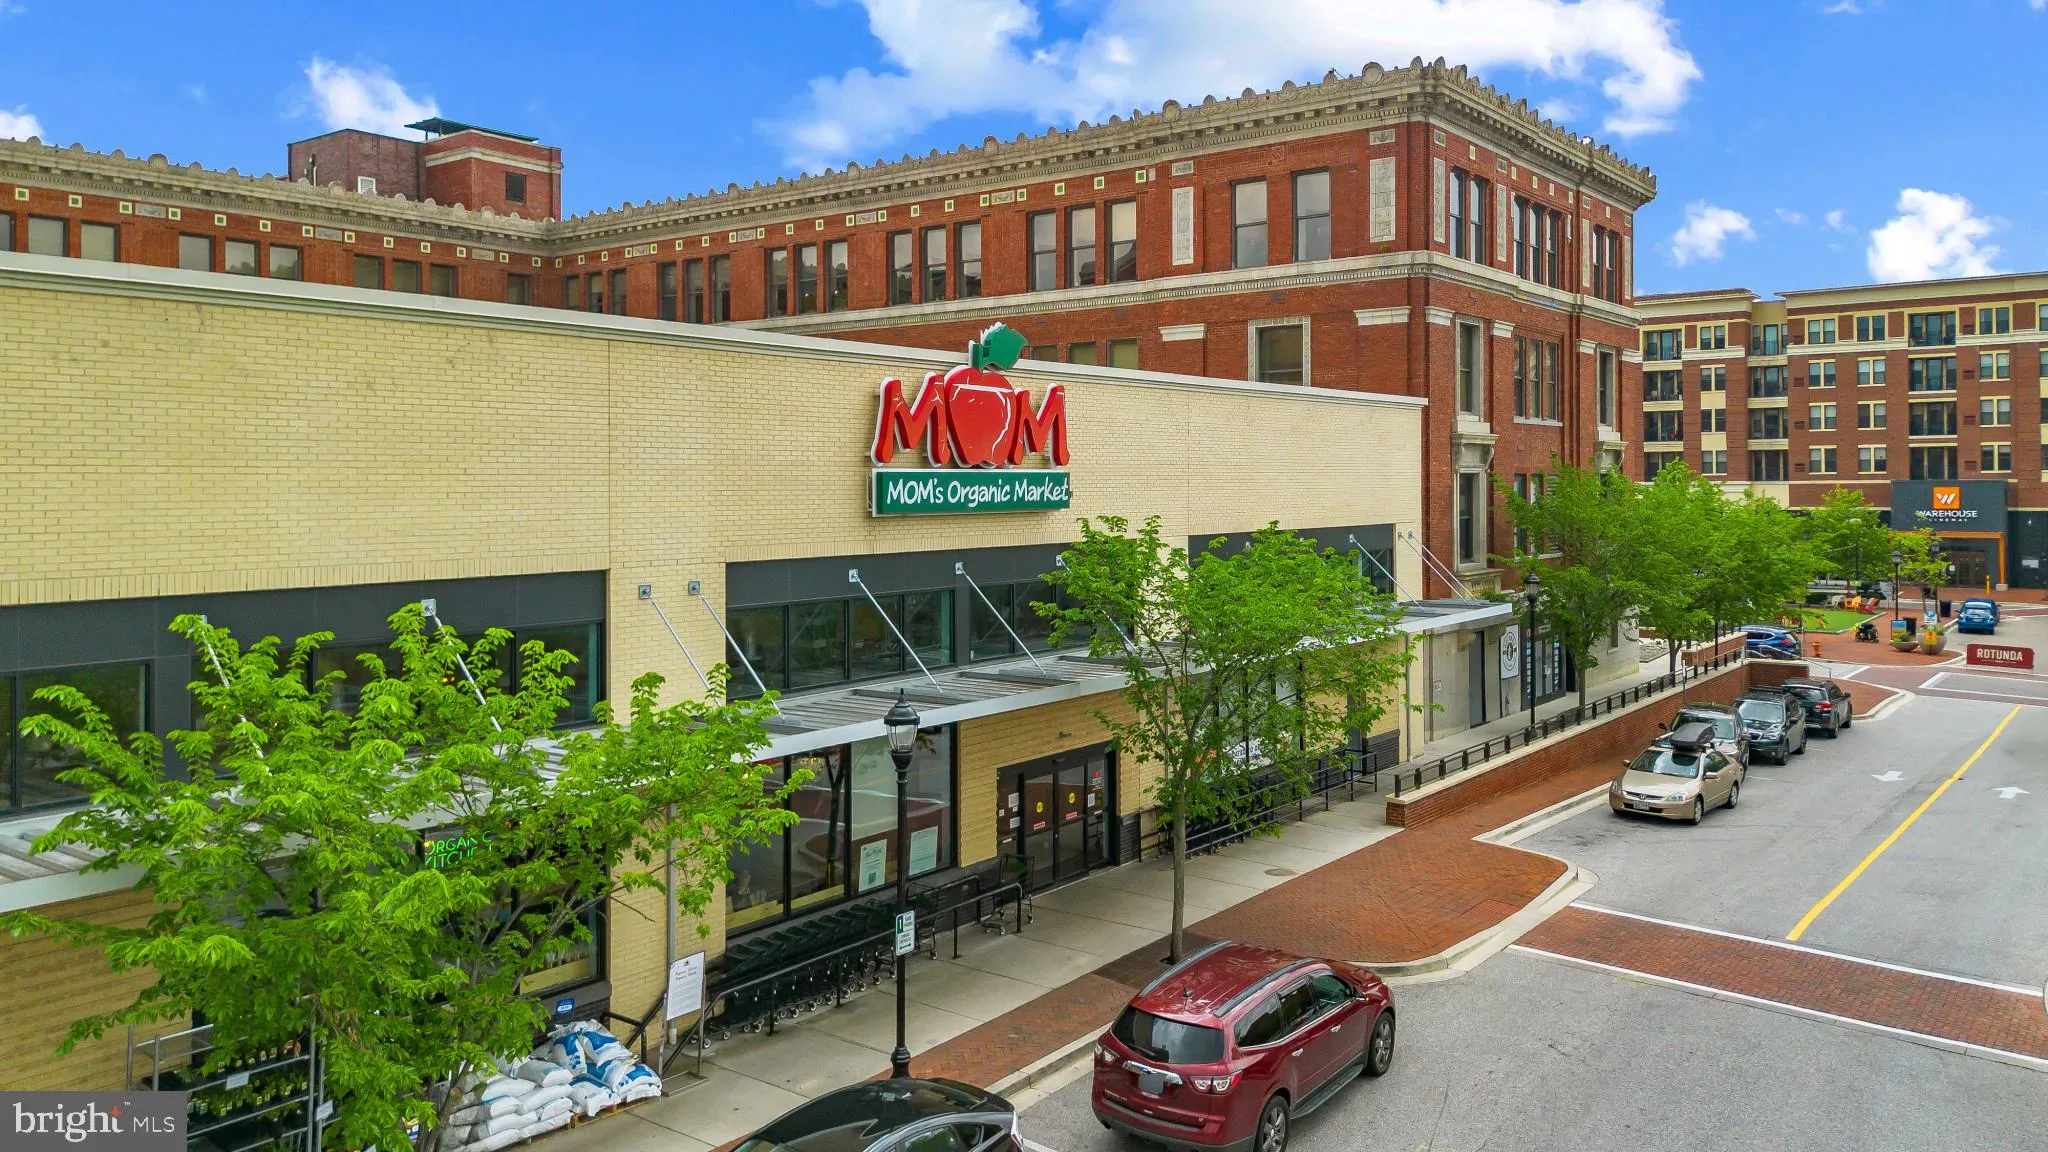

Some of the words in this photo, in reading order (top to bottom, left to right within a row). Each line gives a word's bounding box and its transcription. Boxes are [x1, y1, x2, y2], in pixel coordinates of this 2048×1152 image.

[887, 479, 944, 505] MOM's
[947, 479, 1011, 508] Organic
[1013, 476, 1069, 503] Market
[1915, 510, 1978, 518] WAREHOUSE
[1976, 648, 2023, 662] ROTUNDA
[424, 830, 492, 855] ORGANC
